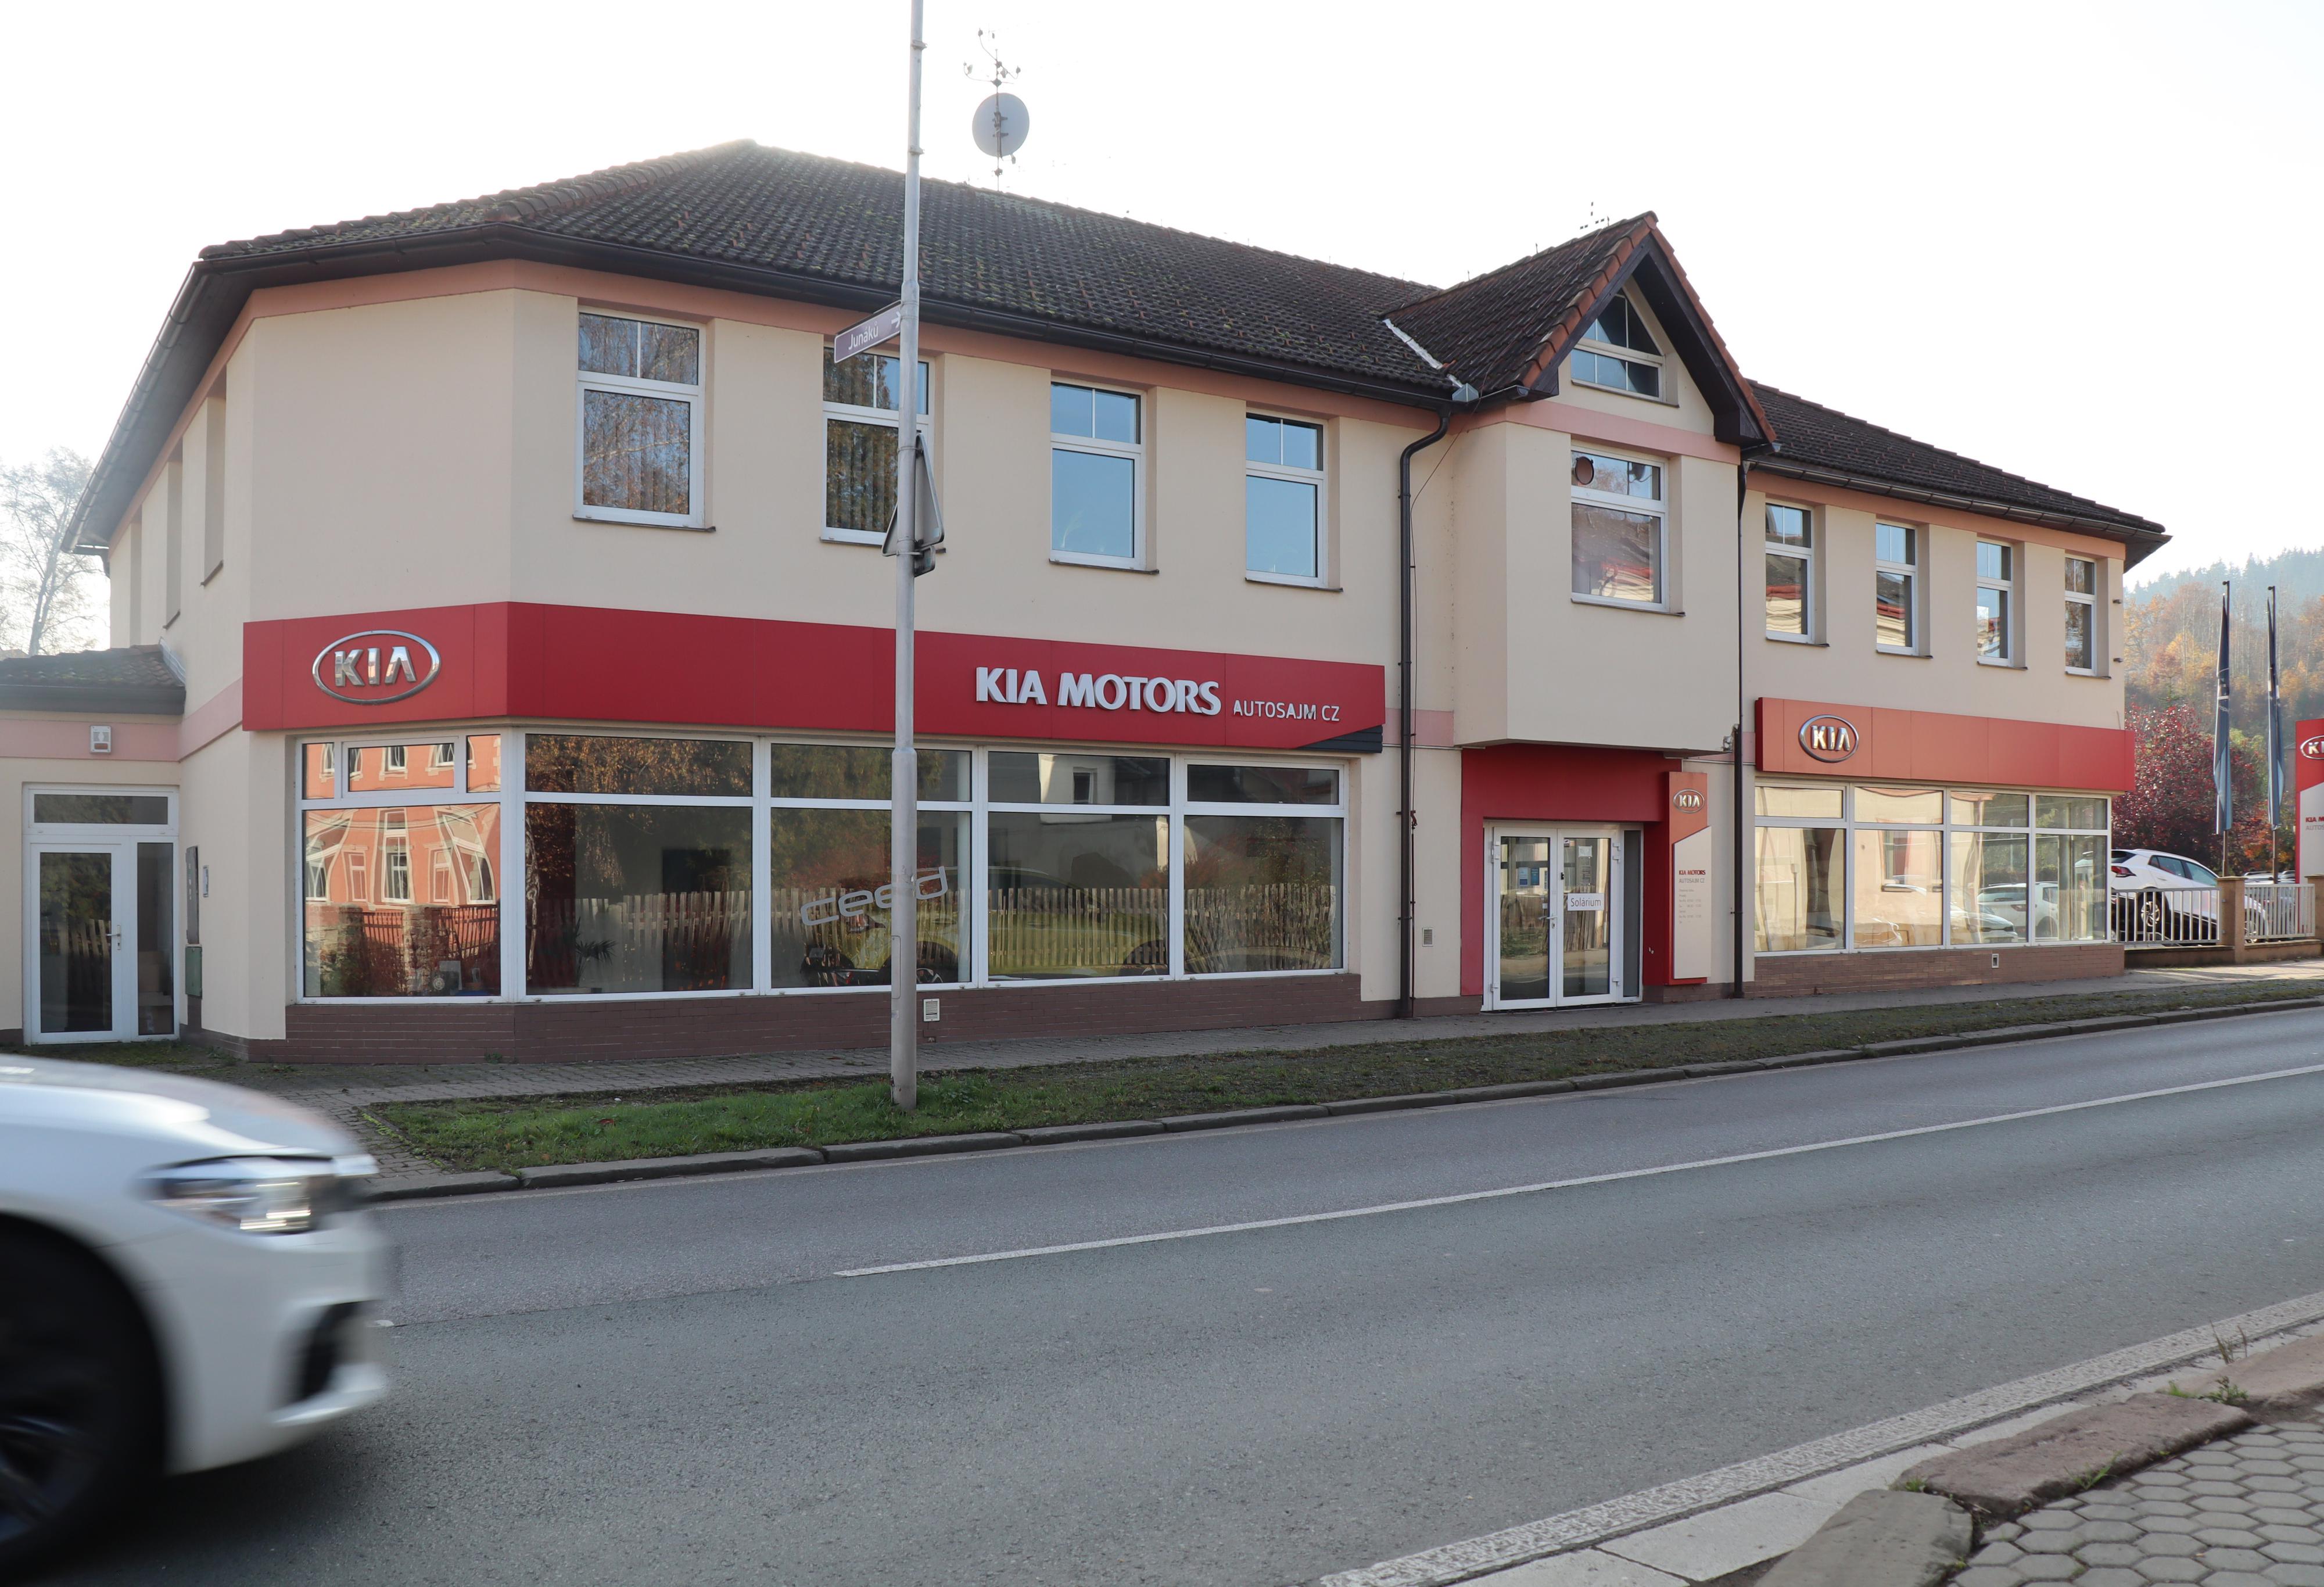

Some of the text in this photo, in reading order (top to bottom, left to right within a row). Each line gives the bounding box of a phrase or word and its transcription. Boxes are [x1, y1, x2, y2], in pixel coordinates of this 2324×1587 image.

[848, 321, 879, 350] Junáků
[334, 646, 417, 687] KIA
[976, 667, 1340, 721] KIA MOTORS AUTOSAJM CZ
[1810, 725, 1850, 752] KIA
[1679, 794, 1700, 808] KIA
[1570, 897, 1601, 907] Solárium
